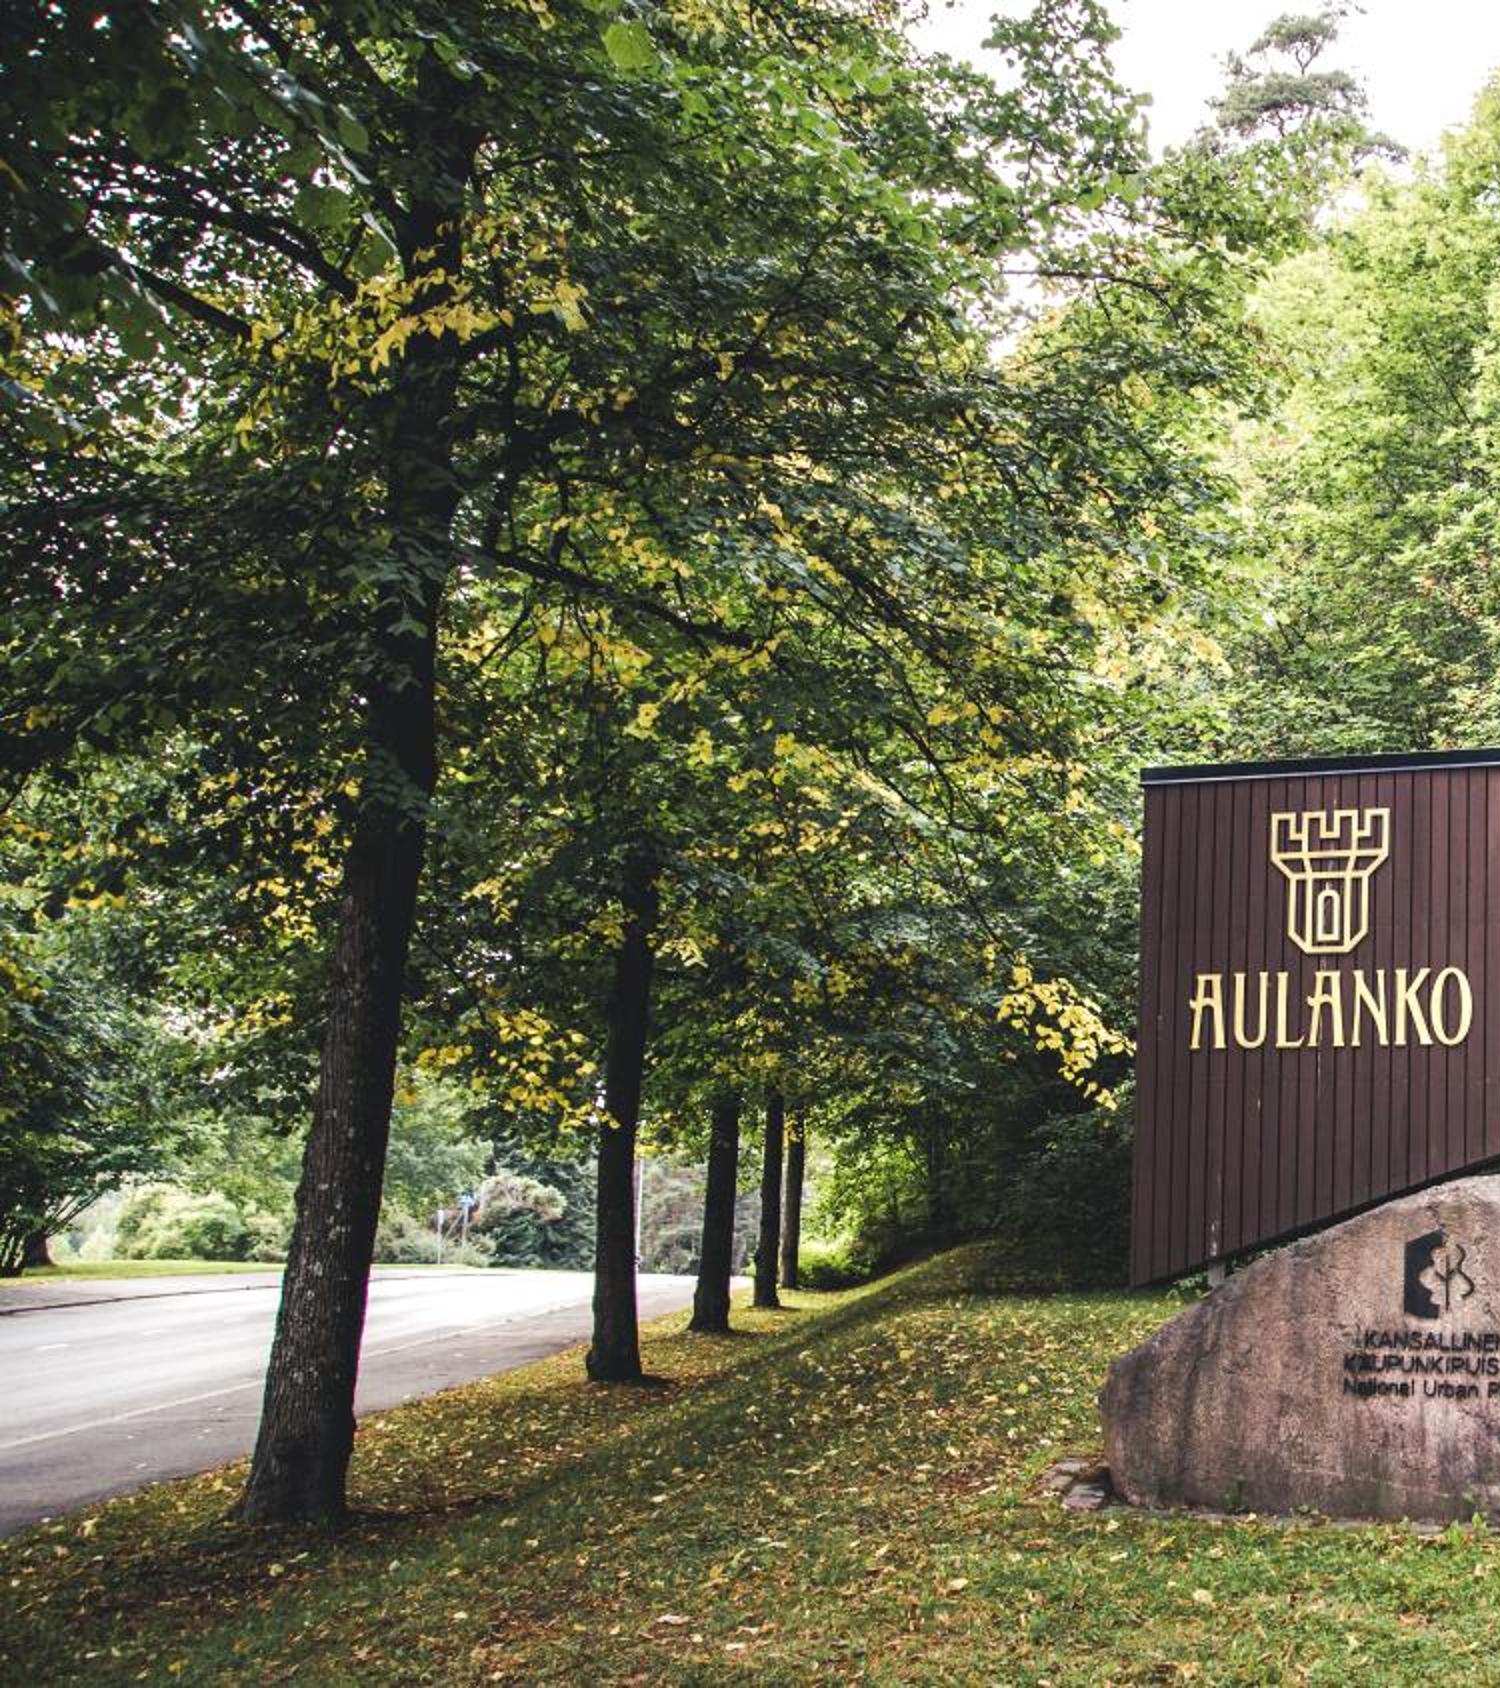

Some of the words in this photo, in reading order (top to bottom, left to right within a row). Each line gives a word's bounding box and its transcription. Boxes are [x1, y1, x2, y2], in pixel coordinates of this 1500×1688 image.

[1189, 966, 1473, 1050] AULANKO
[1343, 1377, 1415, 1397] National
[1423, 1379, 1480, 1399] Urban
